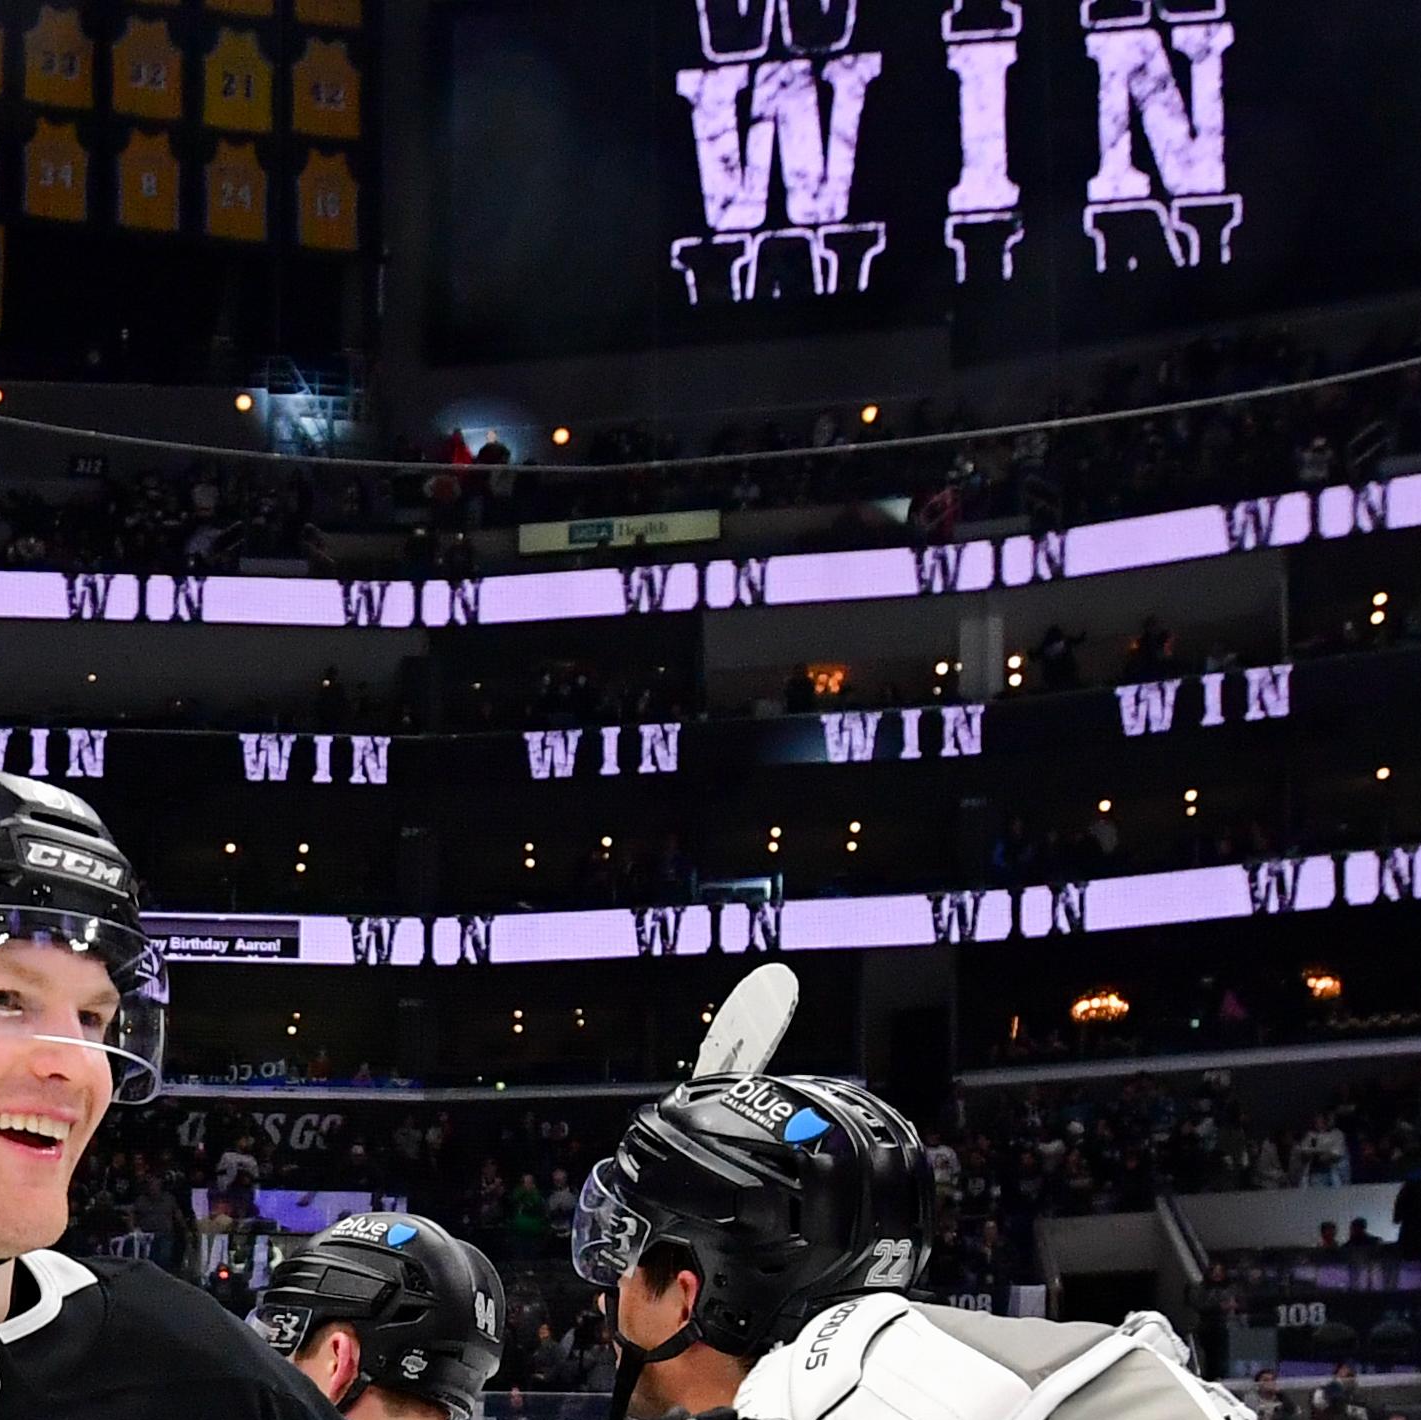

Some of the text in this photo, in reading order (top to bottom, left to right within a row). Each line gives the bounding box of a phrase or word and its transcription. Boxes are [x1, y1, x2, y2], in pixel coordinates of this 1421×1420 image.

[677, 23, 1234, 231] WIN
[1114, 664, 1294, 738] WIN
[238, 732, 391, 786] WIN
[522, 723, 681, 780] WIN
[821, 705, 985, 764] WIN
[26, 840, 124, 887] CCM
[169, 937, 229, 953] Birthday
[234, 938, 281, 951] Aaron!
[722, 1095, 776, 1131] CALIFORNIA
[730, 1075, 793, 1123] blue
[336, 1216, 389, 1237] blue
[864, 1239, 912, 1288] 22
